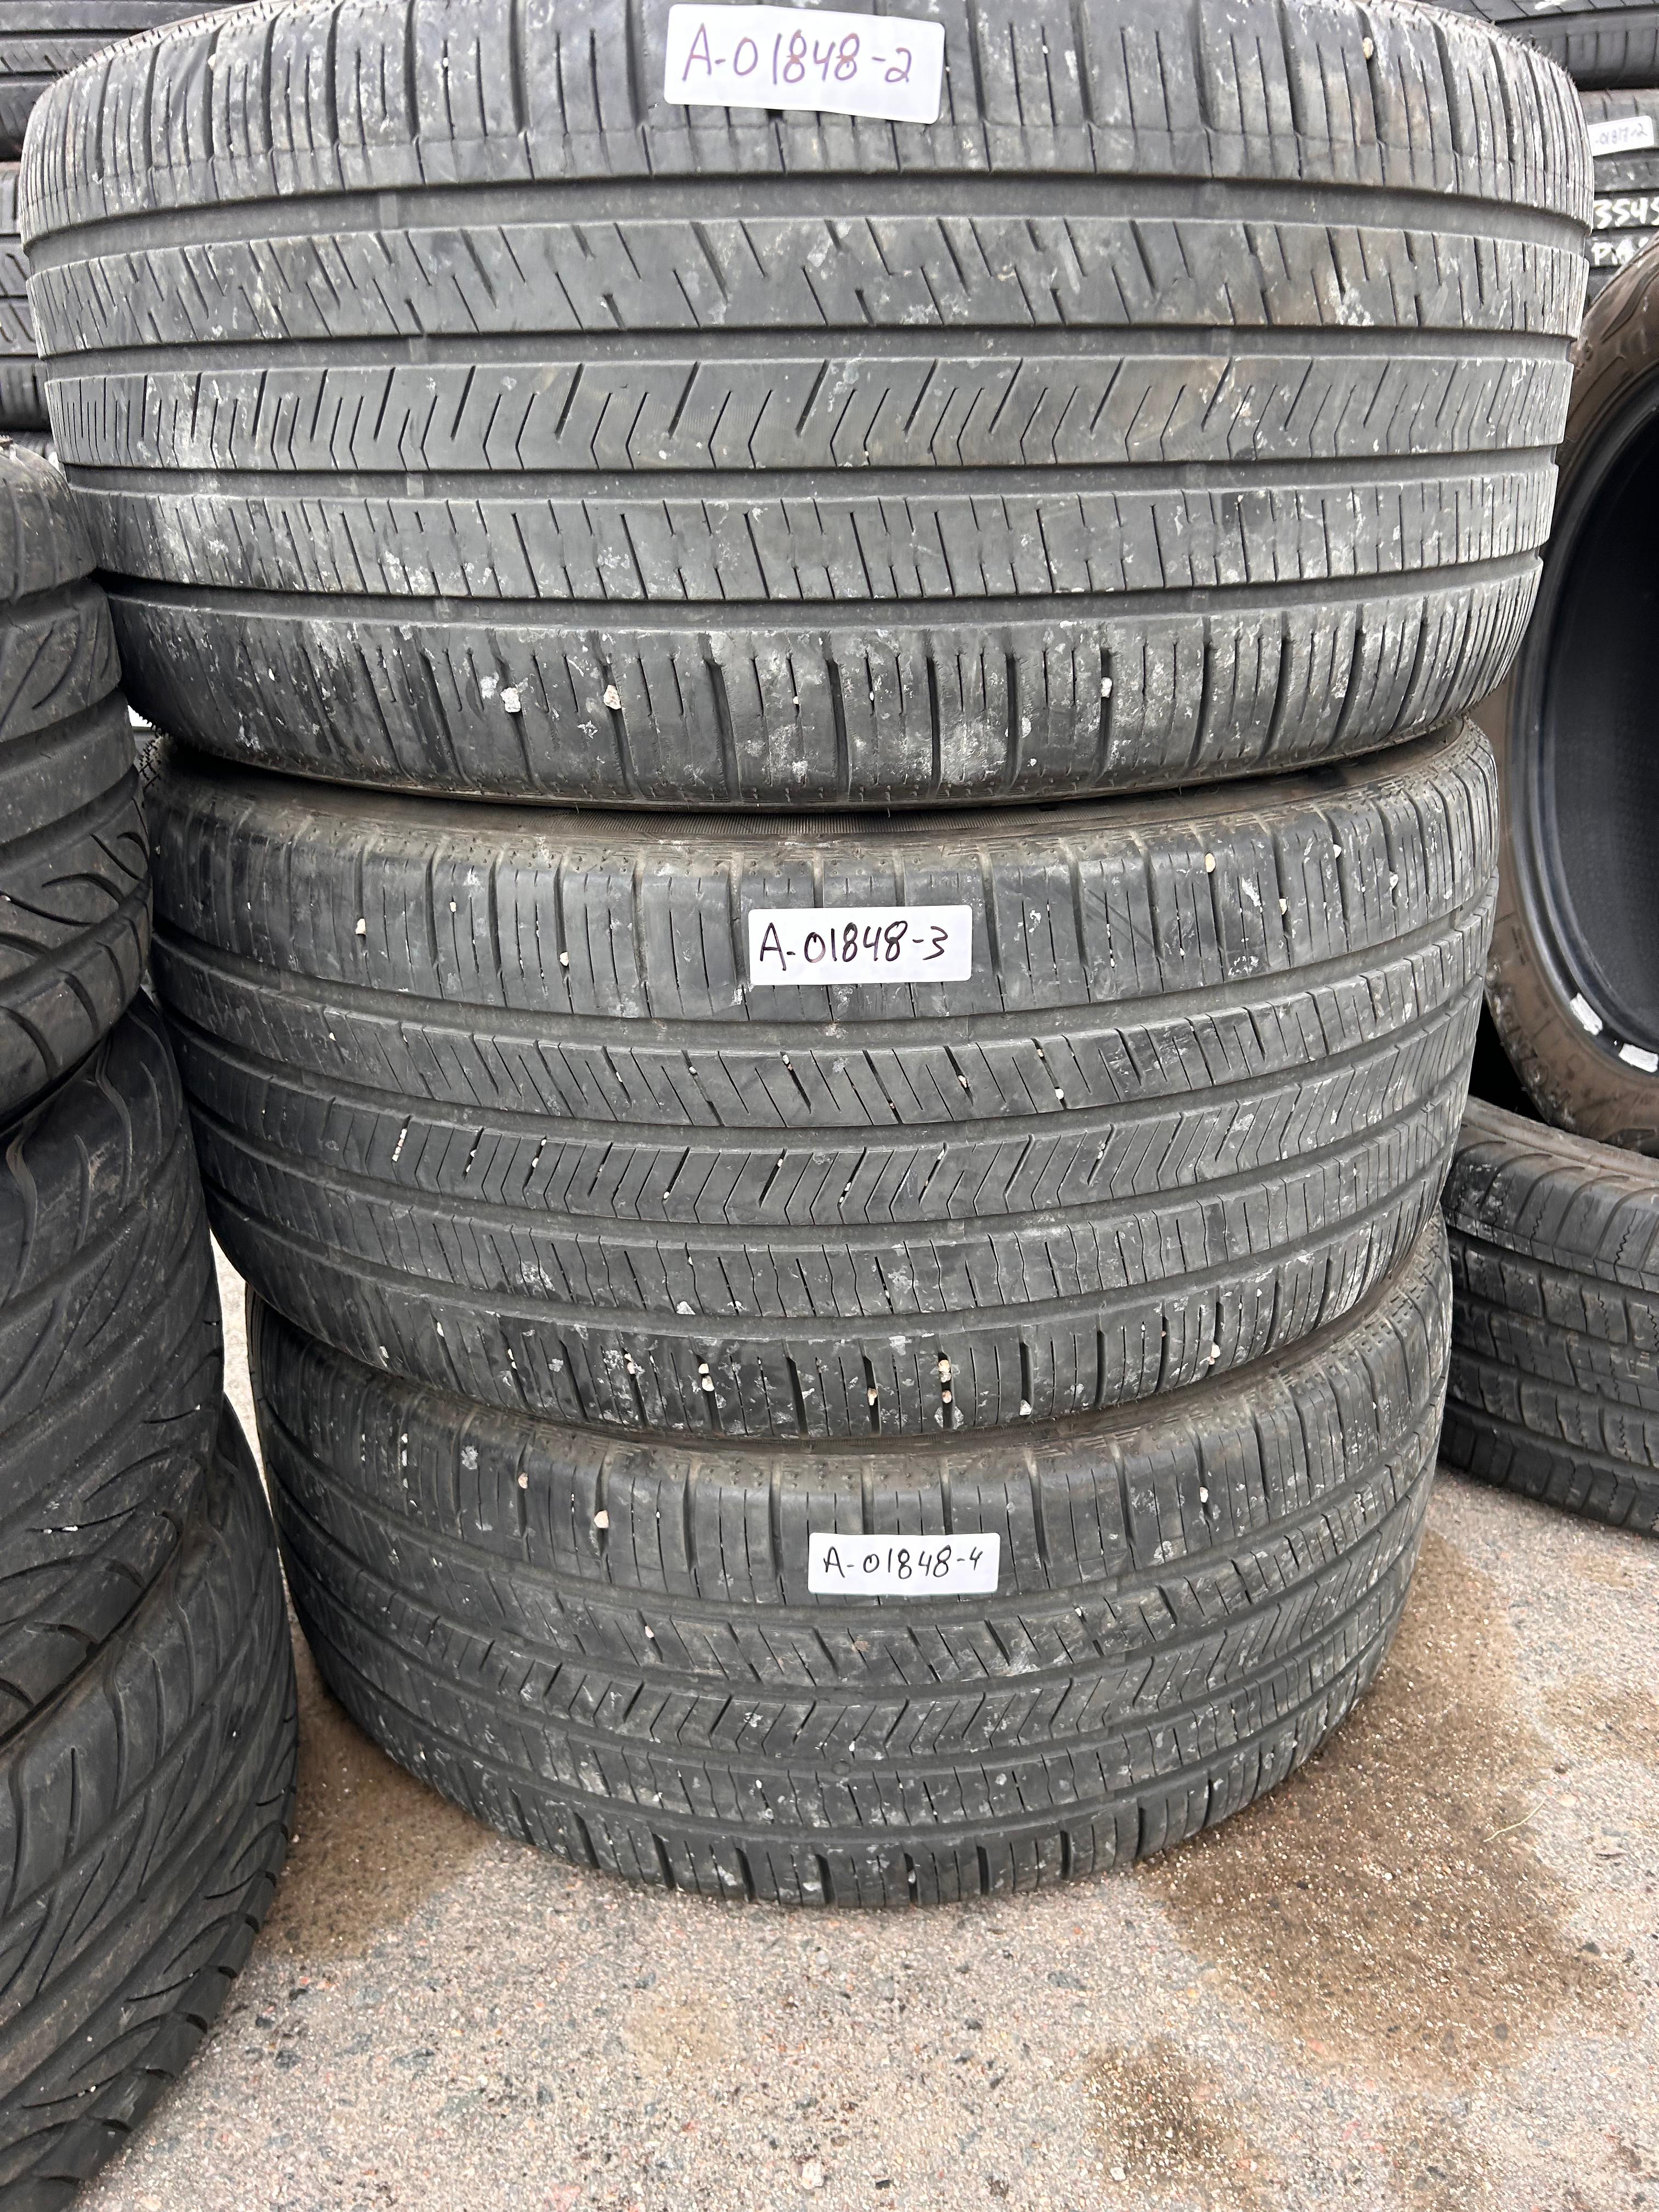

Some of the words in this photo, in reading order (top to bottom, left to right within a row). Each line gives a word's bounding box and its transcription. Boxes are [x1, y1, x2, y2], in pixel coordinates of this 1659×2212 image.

[682, 22, 912, 85] A-01848-2
[760, 920, 948, 970] A-01848-3
[823, 1545, 983, 1579] A-01848-4
